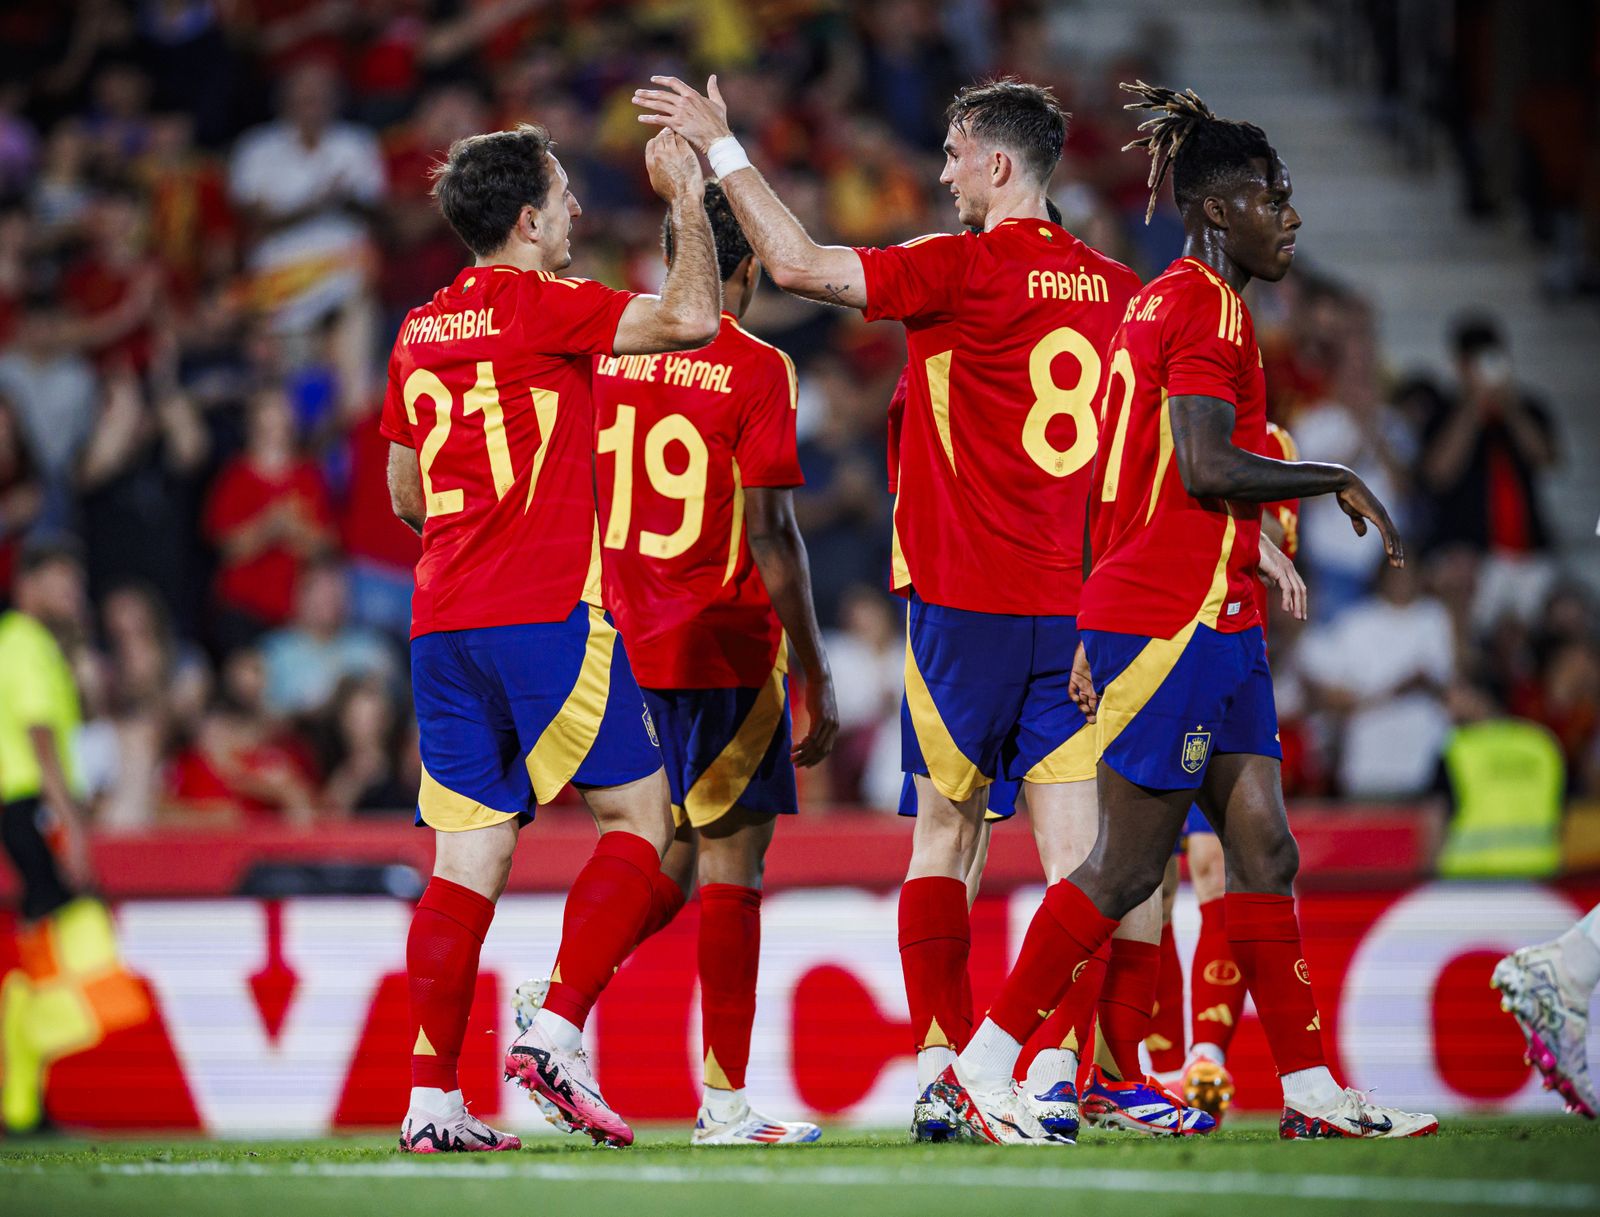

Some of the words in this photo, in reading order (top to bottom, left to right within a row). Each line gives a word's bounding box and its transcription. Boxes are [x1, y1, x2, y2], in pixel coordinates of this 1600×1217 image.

[1027, 265, 1109, 303] FABIÁN
[402, 307, 501, 346] OYARZABAL
[1136, 294, 1163, 322] JR.
[597, 354, 662, 382] LAMINE
[663, 355, 733, 394] YAMAL
[1021, 326, 1102, 478] 8
[403, 361, 516, 518] 21
[597, 404, 709, 560] 19
